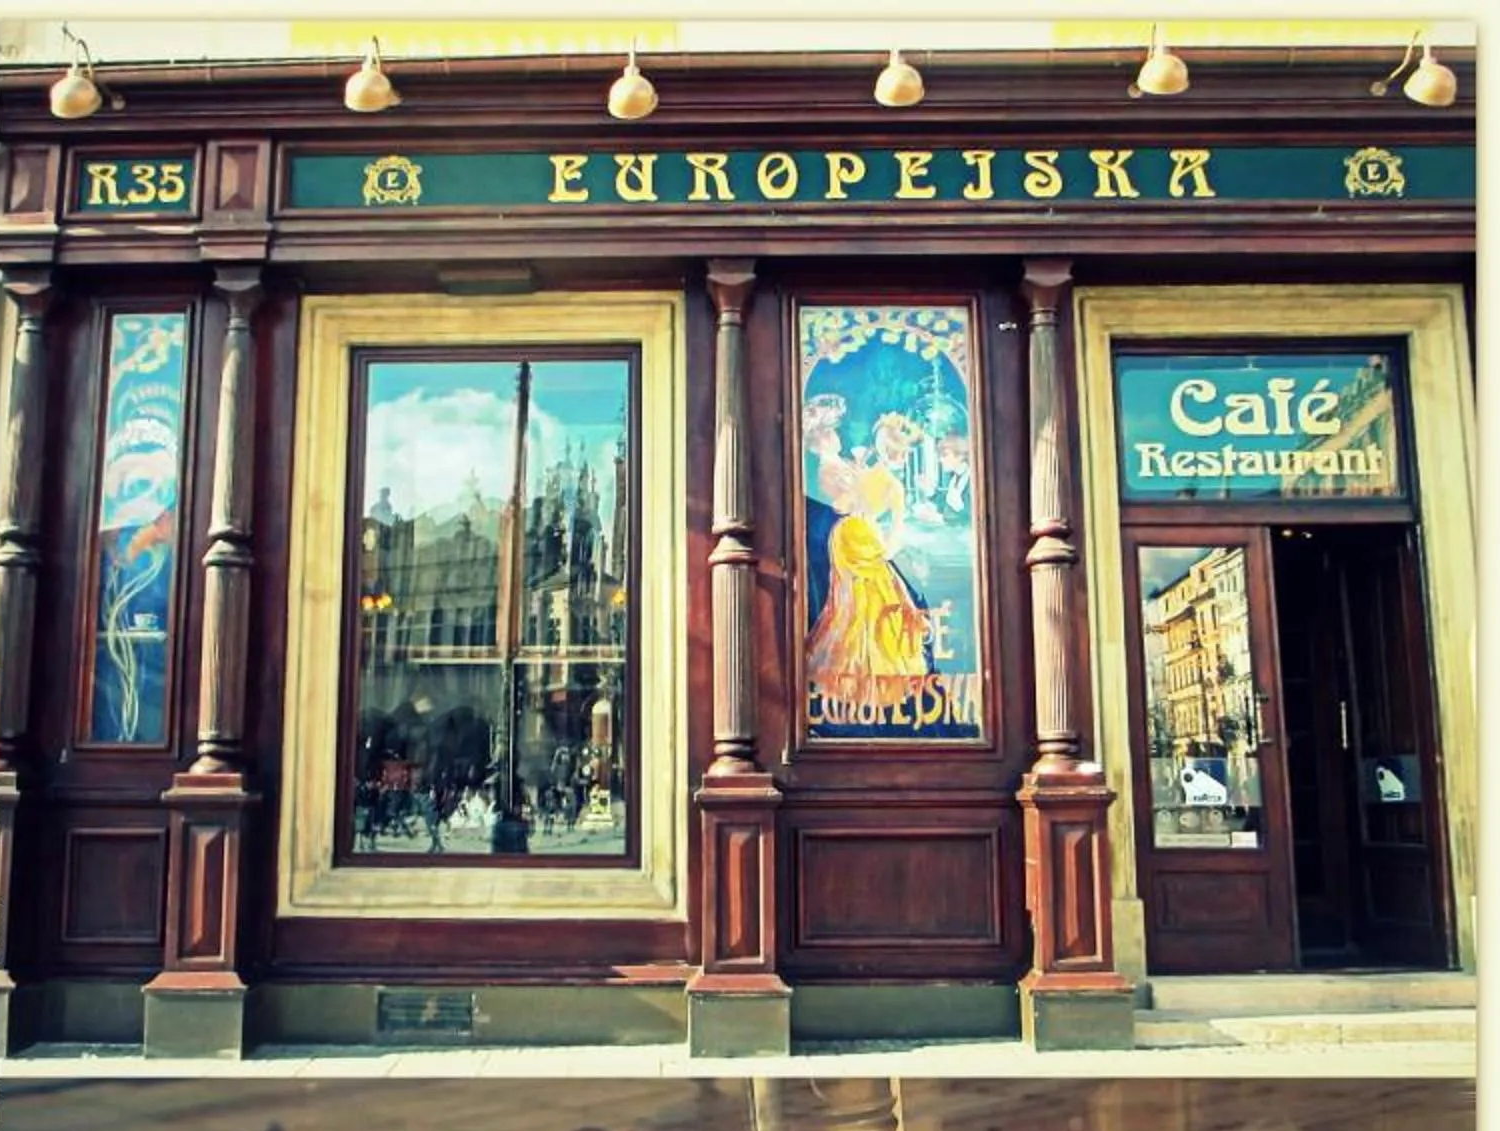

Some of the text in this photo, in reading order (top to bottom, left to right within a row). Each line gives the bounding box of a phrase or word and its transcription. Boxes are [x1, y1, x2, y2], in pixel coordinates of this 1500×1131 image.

[547, 149, 1216, 202] EUROPEJSKA
[1169, 378, 1342, 437] Café
[1134, 434, 1384, 478] Restaurant
